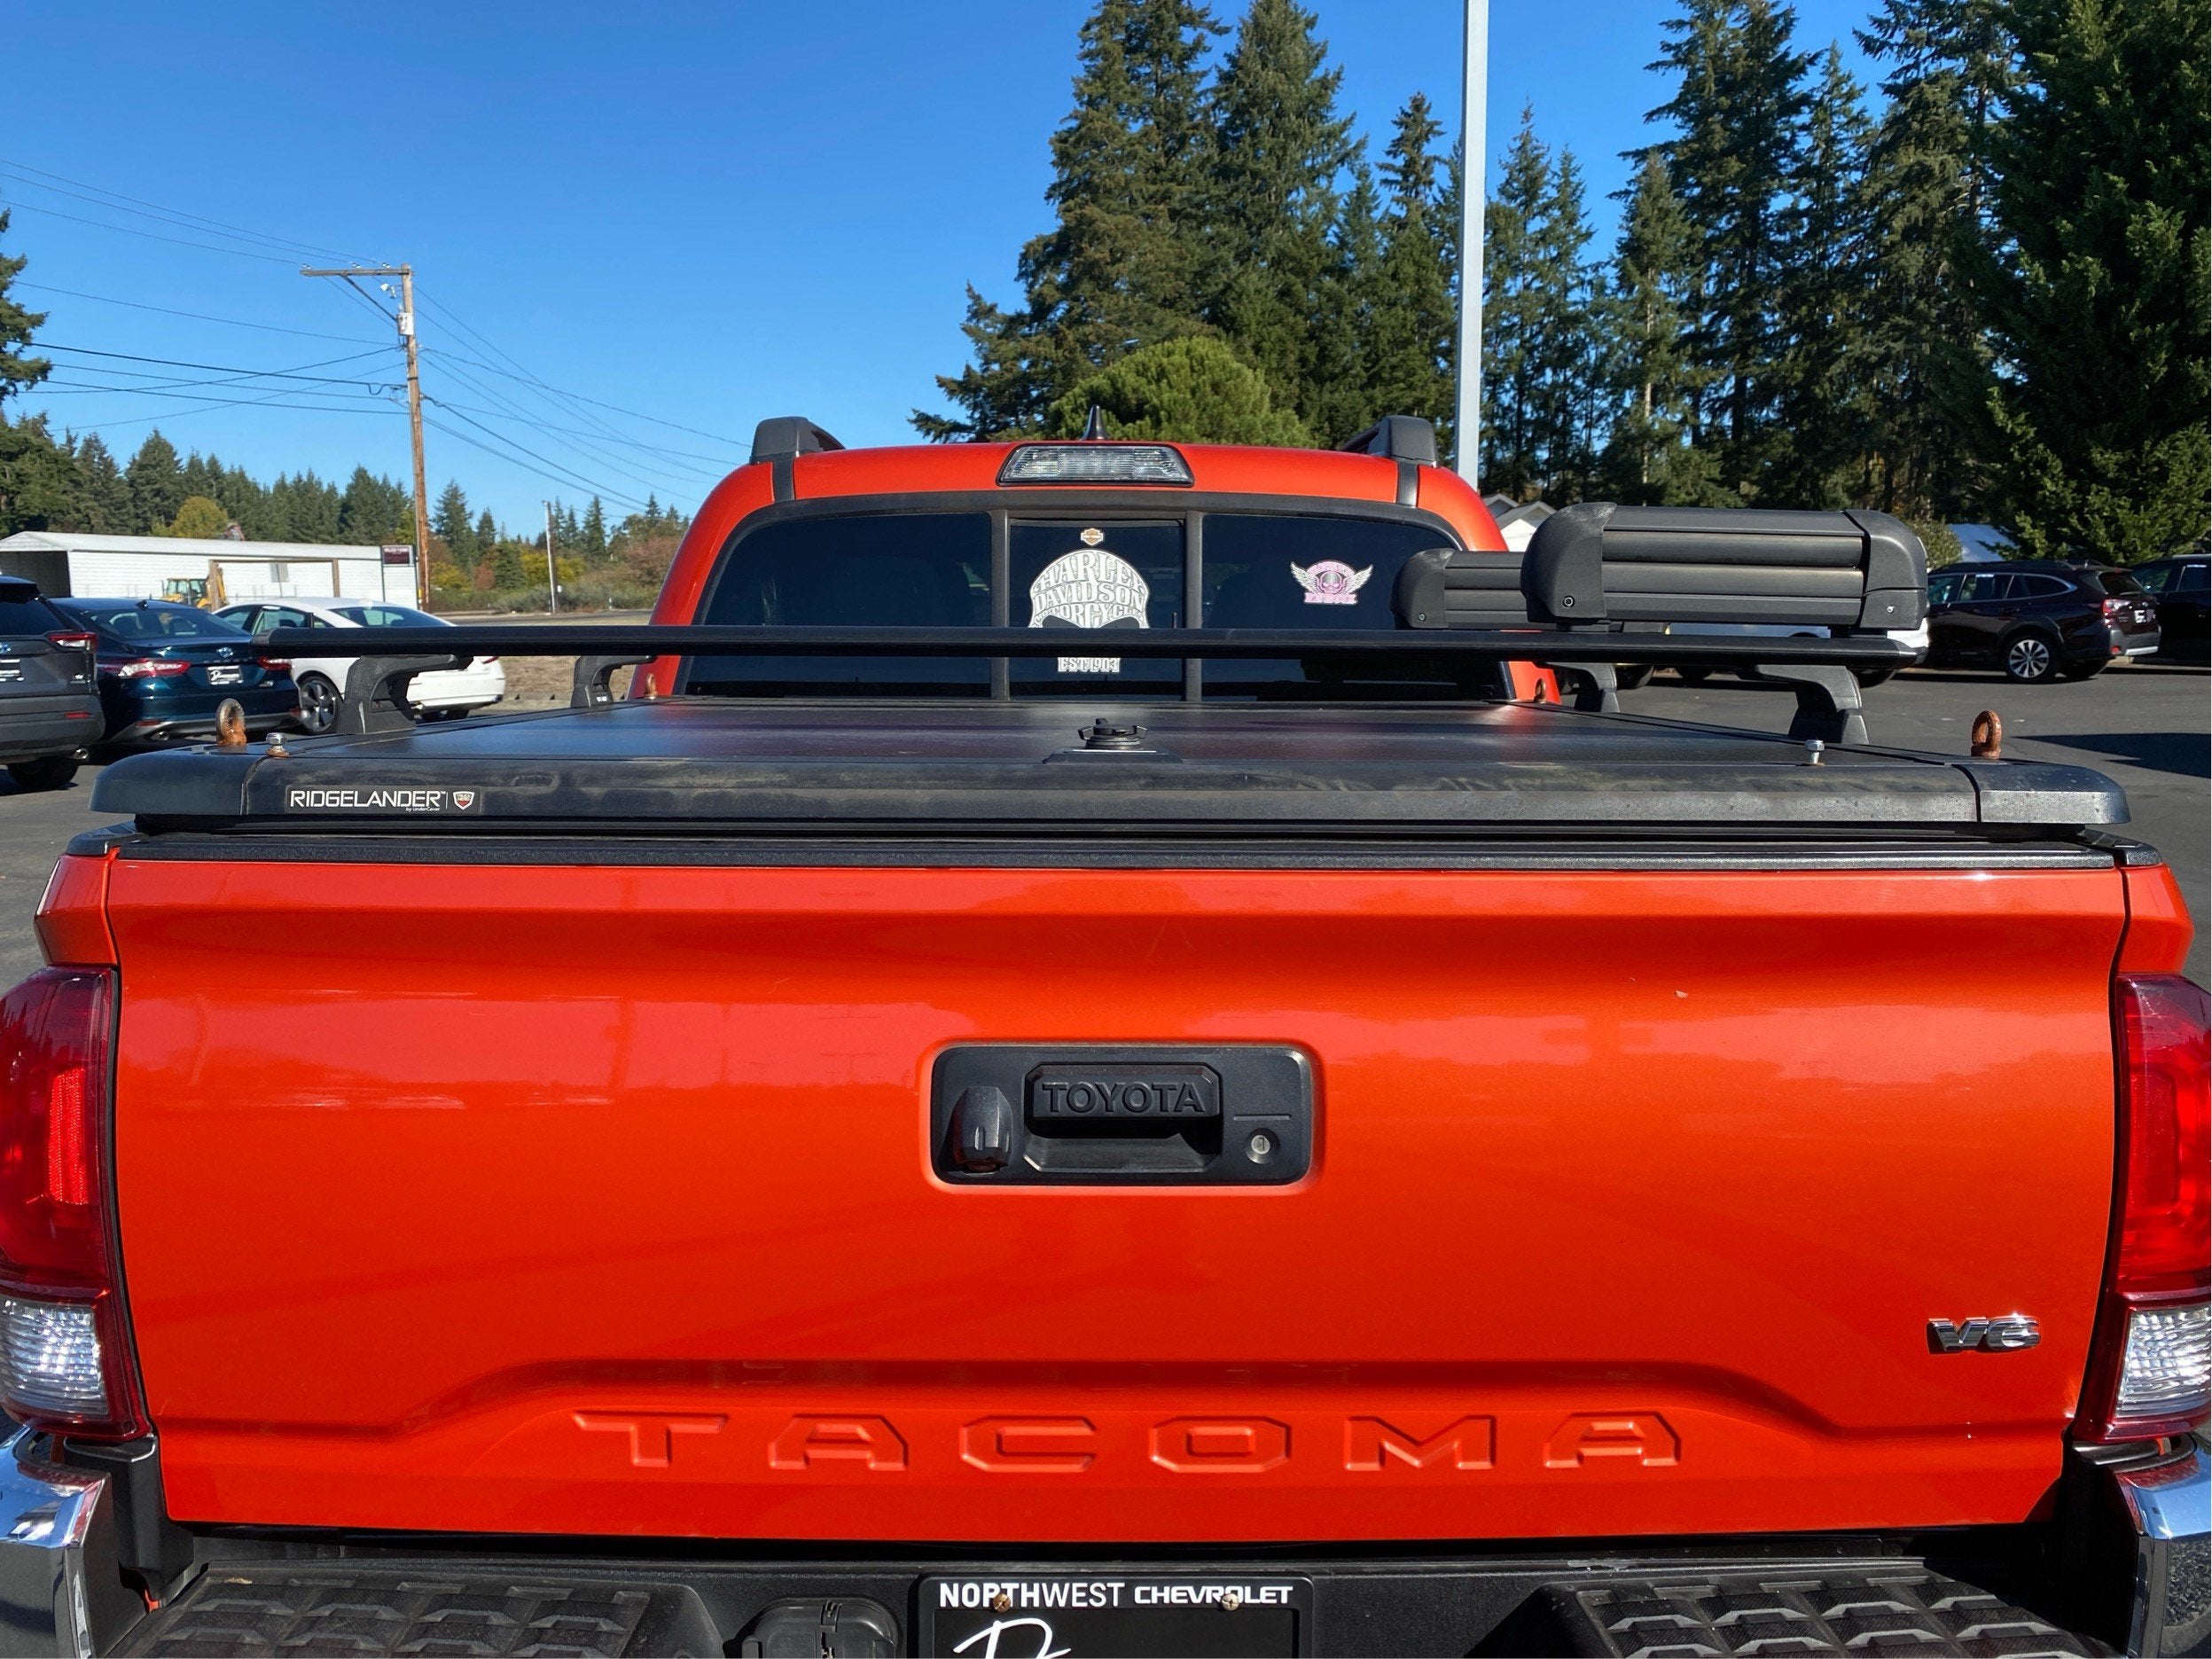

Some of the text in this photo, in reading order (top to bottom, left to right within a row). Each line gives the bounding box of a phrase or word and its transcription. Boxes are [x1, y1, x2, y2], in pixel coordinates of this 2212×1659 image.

[1033, 552, 1147, 595] HARLEY
[1035, 580, 1144, 613] DAVIDSON
[290, 790, 441, 808] RIDGELANDER
[1042, 1081, 1206, 1114] TOYOTA
[1927, 1315, 2041, 1353] V6
[572, 1411, 1682, 1474] TACOMA
[939, 1582, 1294, 1608] NORTHWEST CHEVROLET
